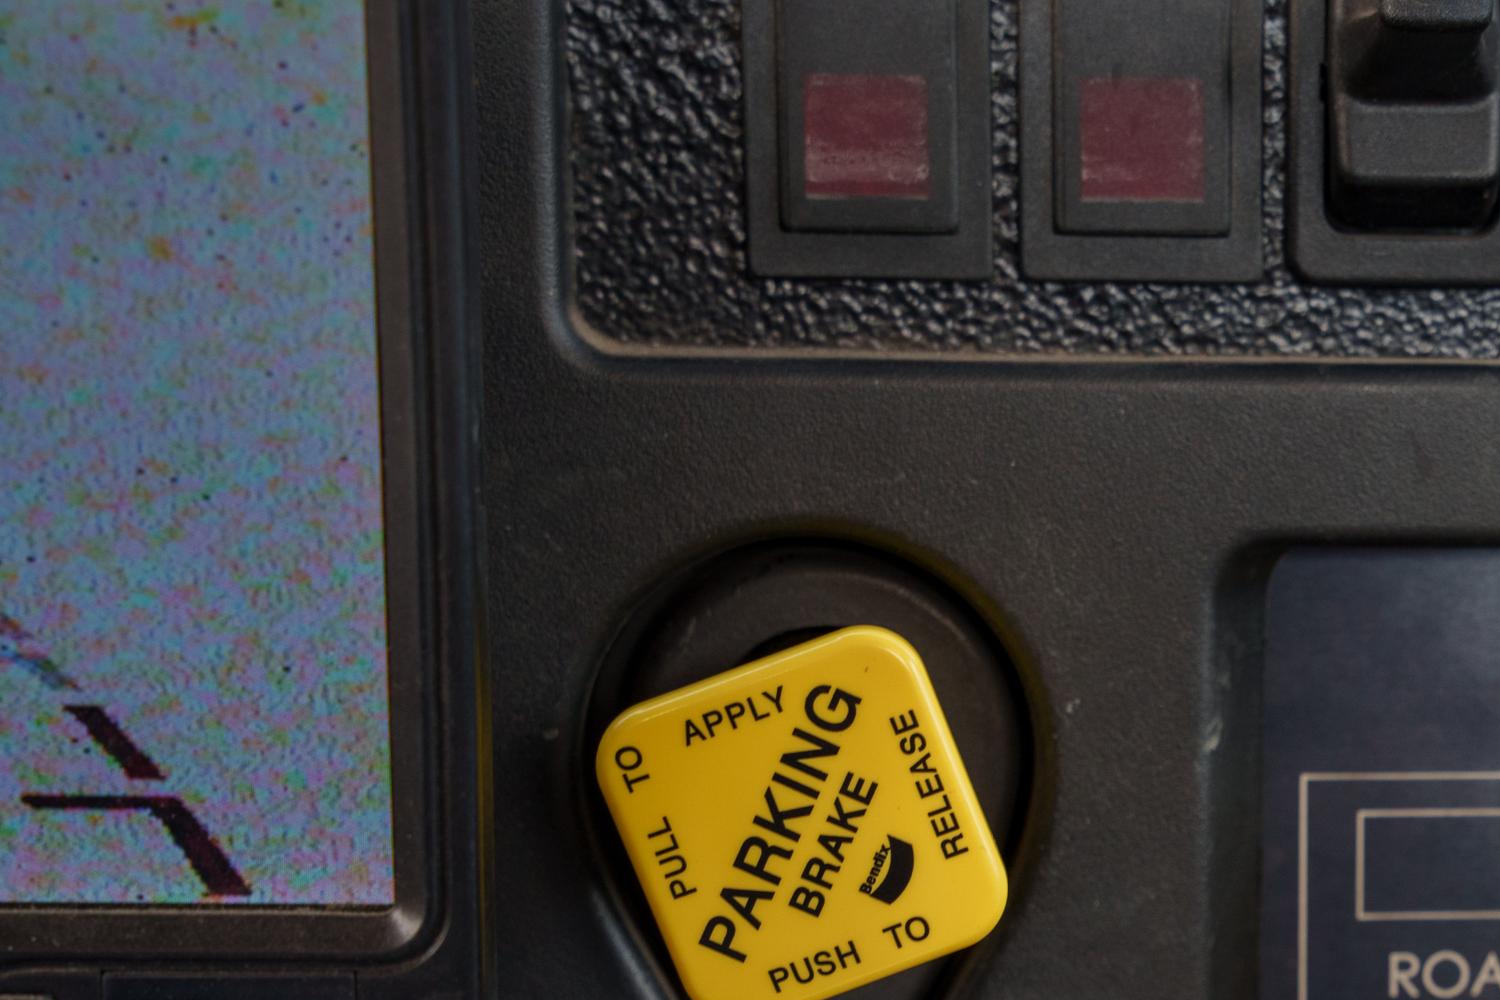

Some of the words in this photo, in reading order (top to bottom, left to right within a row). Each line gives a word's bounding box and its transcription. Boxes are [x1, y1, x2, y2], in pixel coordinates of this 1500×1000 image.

[682, 685, 787, 747] APPLY
[614, 745, 650, 793] TO
[890, 708, 969, 860] RELEASE
[647, 816, 697, 900] PULL
[698, 684, 863, 963] PARKING
[788, 771, 879, 917] BRAKE
[859, 843, 891, 896] Bendix
[768, 940, 861, 993] PUSH
[883, 916, 930, 949] TO
